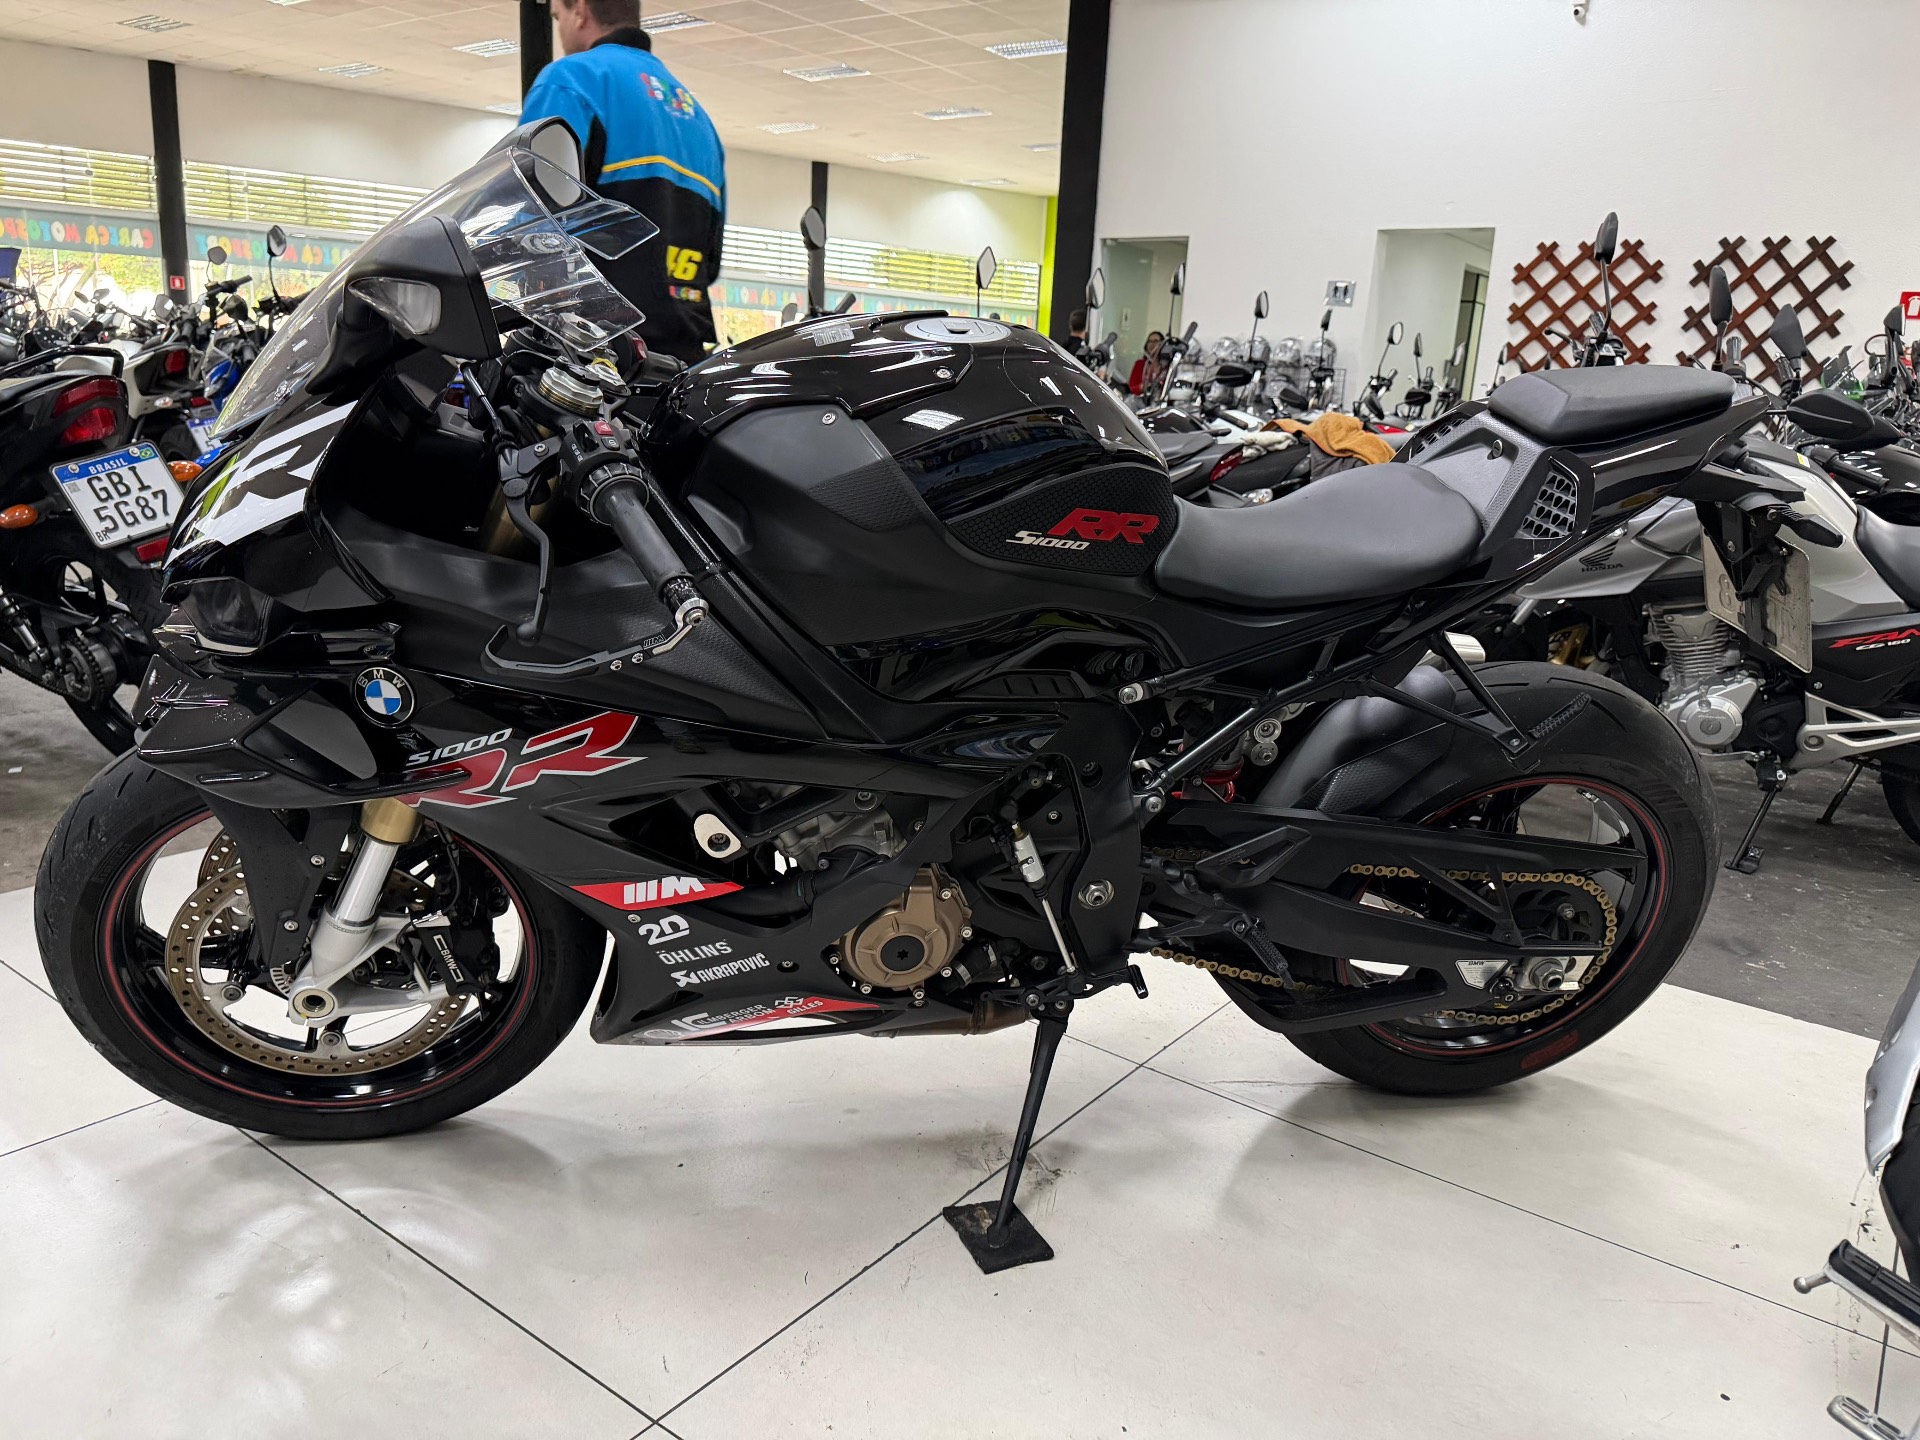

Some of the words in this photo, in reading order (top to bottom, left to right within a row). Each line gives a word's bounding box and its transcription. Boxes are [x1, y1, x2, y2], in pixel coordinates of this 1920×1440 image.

[88, 458, 128, 475] BRASIL
[87, 466, 152, 503] GBI
[93, 489, 170, 533] 5G87
[95, 530, 111, 542] BR
[1047, 507, 1160, 545] RR
[1005, 530, 1090, 550] S1000
[1581, 562, 1624, 573] HONDA
[357, 669, 406, 689] BMW
[406, 727, 514, 767] S1000
[440, 949, 458, 971] BMW
[656, 940, 733, 965] ÖHLINS
[786, 1000, 824, 1015] GILLES
